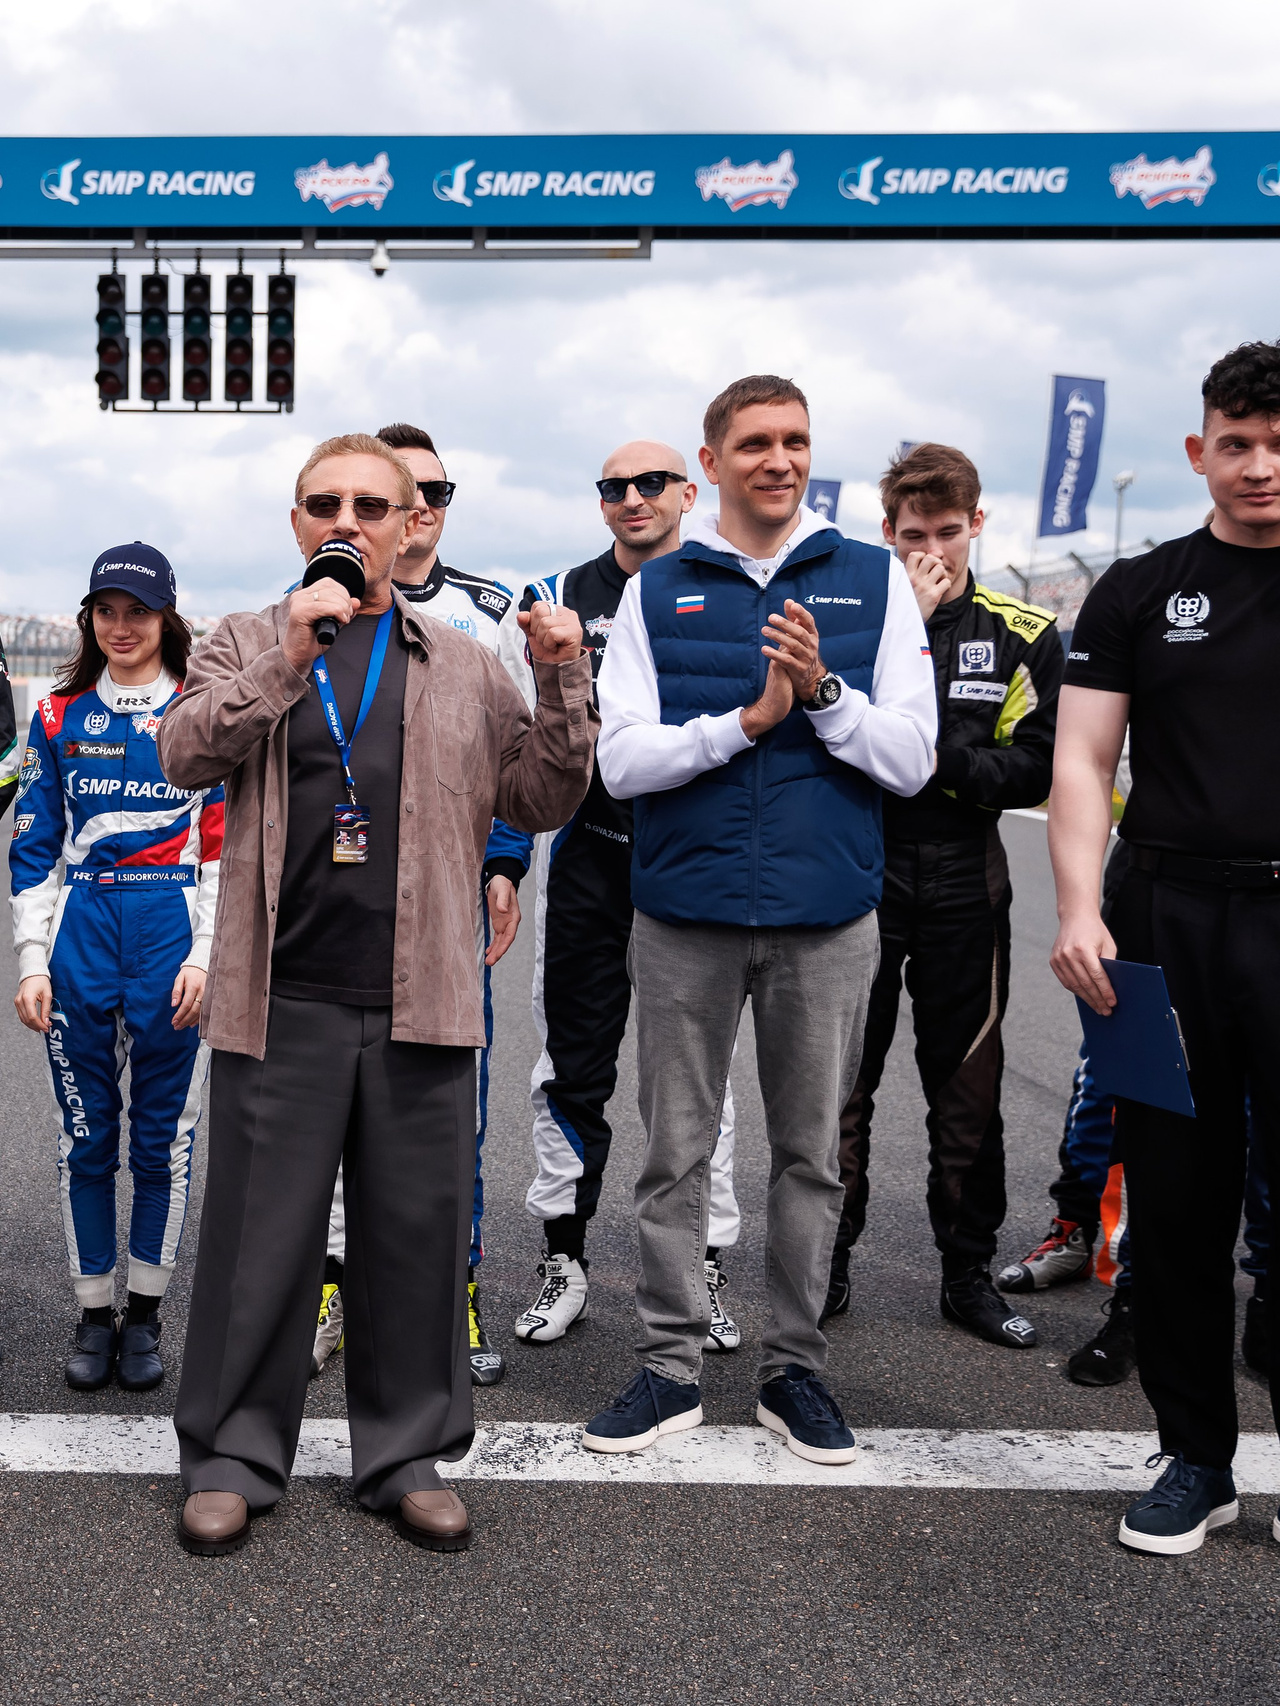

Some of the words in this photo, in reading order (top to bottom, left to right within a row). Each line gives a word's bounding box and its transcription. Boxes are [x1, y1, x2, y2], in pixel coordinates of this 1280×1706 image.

[80, 169, 146, 196] SMP
[146, 170, 256, 196] RACING
[474, 170, 541, 197] SMP
[542, 170, 656, 197] RACING
[880, 167, 950, 195] SMP
[951, 166, 1069, 194] RACING
[1066, 413, 1087, 460] SMP
[1052, 457, 1082, 528] RACING
[105, 563, 123, 571] SMP
[123, 563, 157, 578] RACING
[480, 591, 506, 611] OMP
[815, 596, 833, 604] SMP
[833, 597, 862, 606] RACING
[1012, 616, 1039, 631] OMP
[116, 695, 152, 706] HRX
[326, 702, 338, 726] RACING
[78, 745, 125, 756] YOKOHAMA
[78, 778, 122, 796] SMP
[123, 780, 196, 800] RACING
[357, 833, 367, 846] VIP
[48, 1027, 70, 1068] SMP
[60, 1069, 90, 1138] RACING
[546, 1265, 562, 1273] OMP
